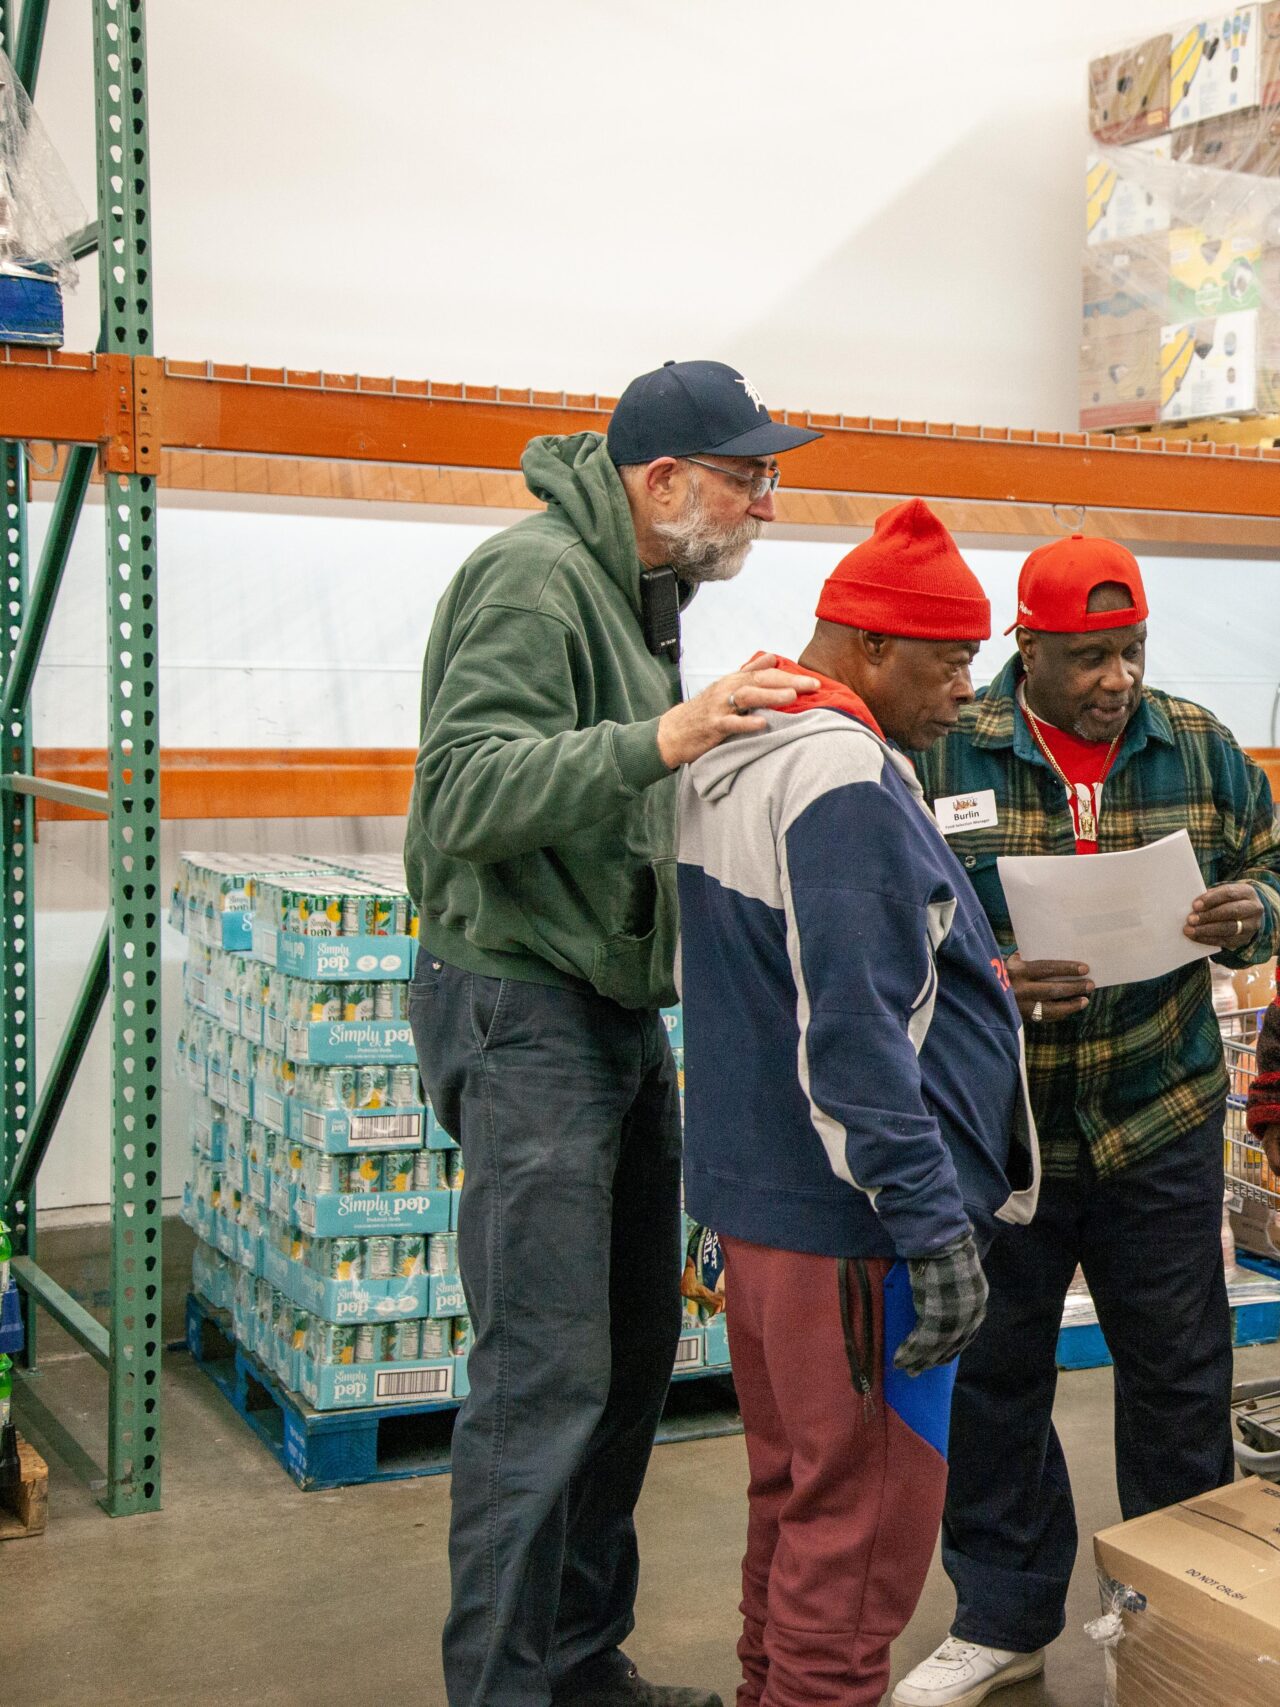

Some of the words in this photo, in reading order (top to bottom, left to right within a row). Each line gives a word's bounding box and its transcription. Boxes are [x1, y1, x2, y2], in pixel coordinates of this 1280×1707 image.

[954, 811, 979, 821] Burlin
[328, 1025, 380, 1046] Simply
[337, 1194, 391, 1217] Simply
[393, 1196, 430, 1215] pop
[333, 1382, 367, 1400] pop
[1185, 1568, 1201, 1577] DO
[1199, 1575, 1220, 1586] NOT
[1216, 1584, 1247, 1600] CRUSH
